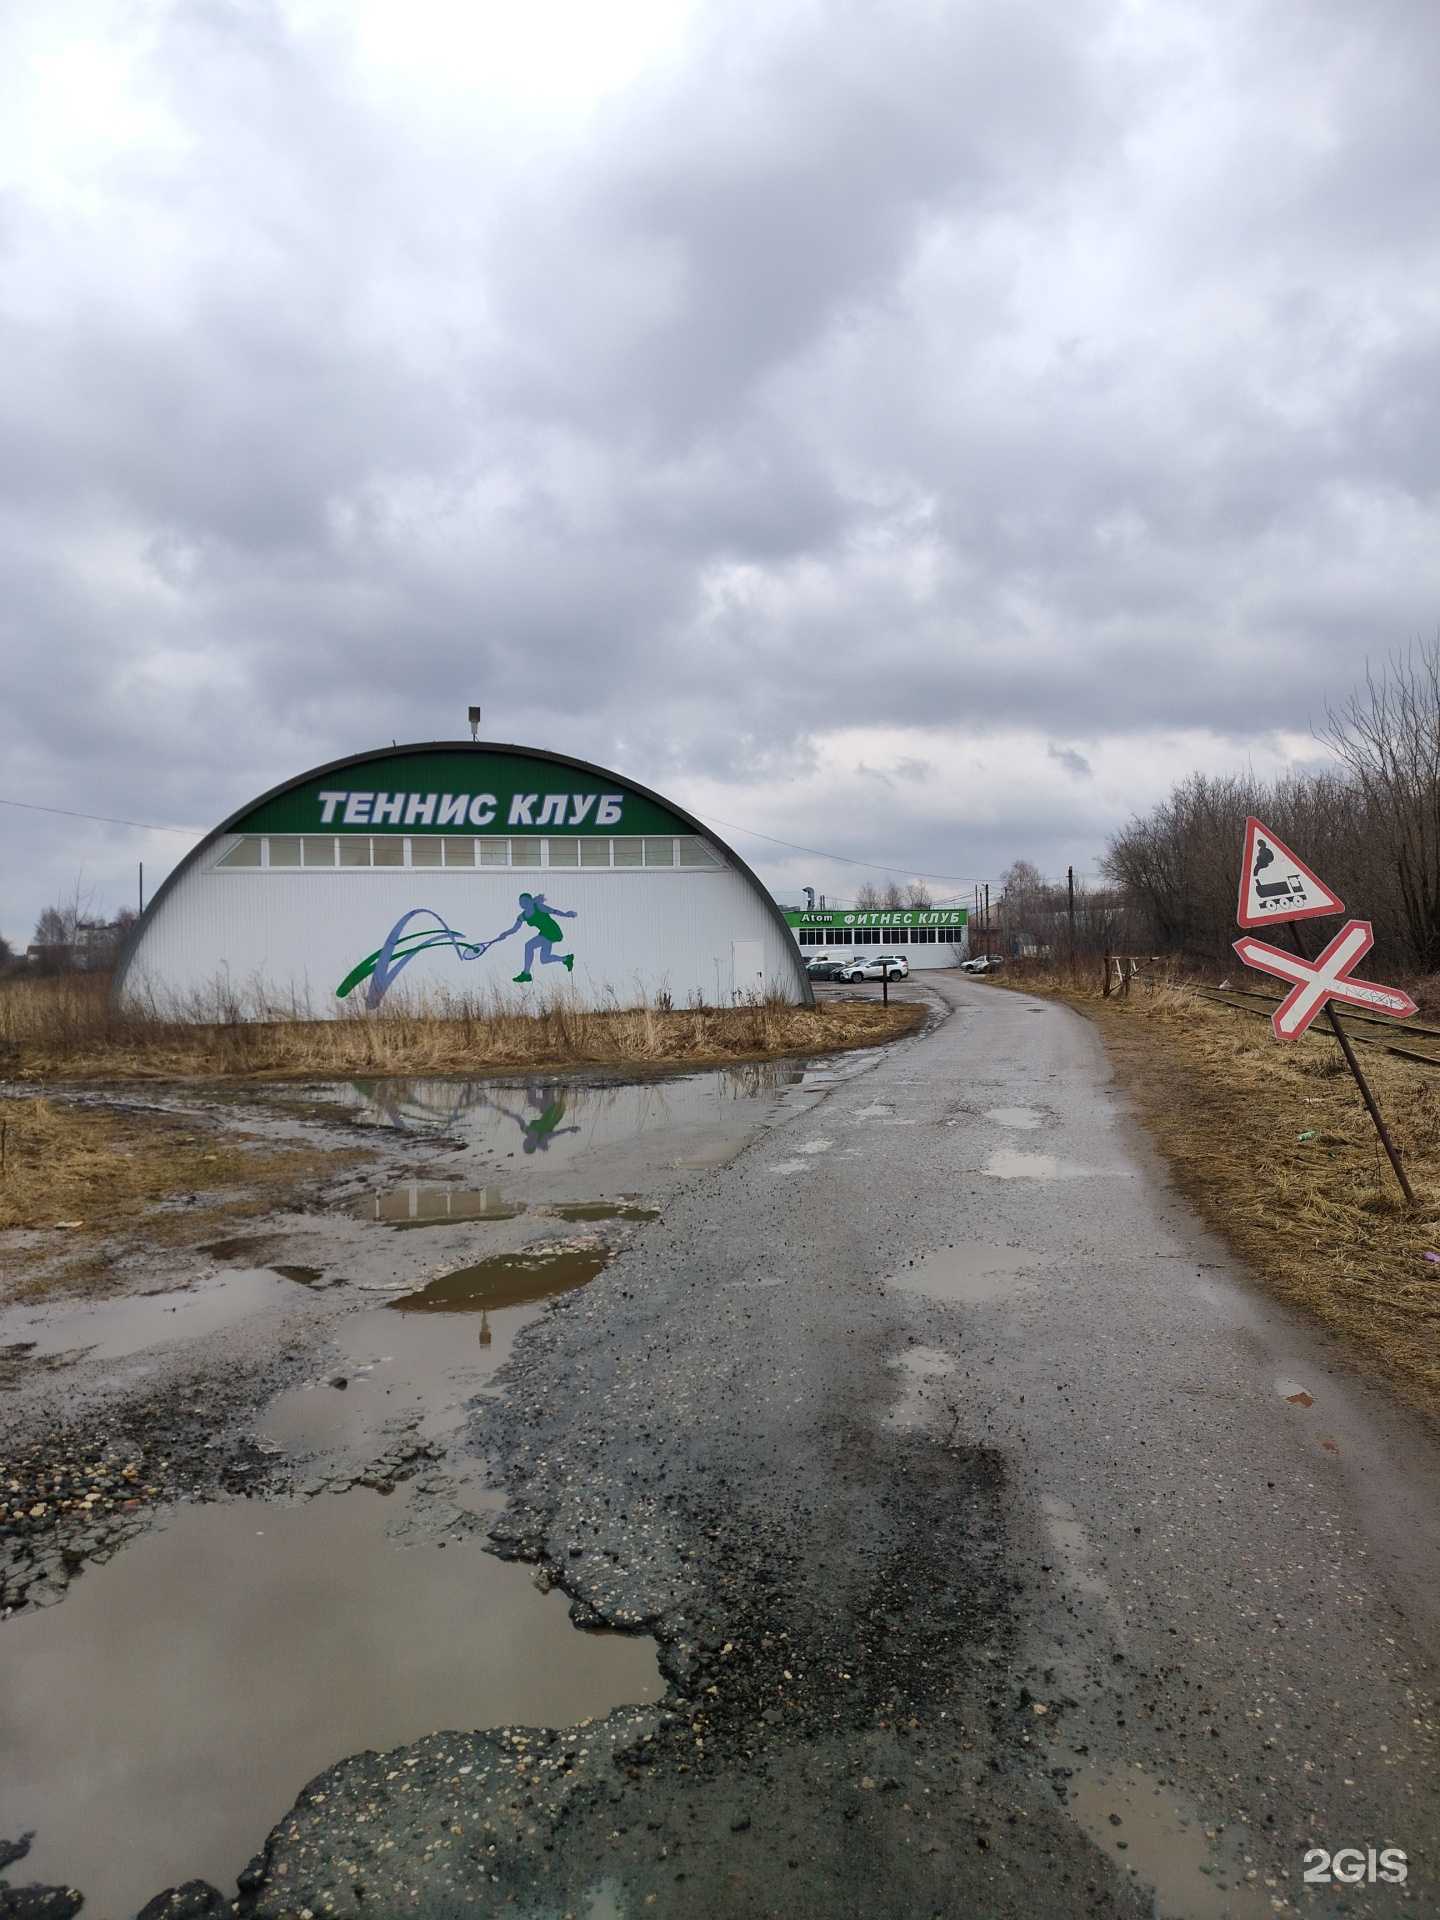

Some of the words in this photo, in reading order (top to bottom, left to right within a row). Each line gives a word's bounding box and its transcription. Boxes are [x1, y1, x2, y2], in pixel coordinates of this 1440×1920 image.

[318, 791, 498, 825] ТЕННИС
[507, 793, 624, 826] КЛУБ
[801, 913, 833, 922] Atom
[843, 913, 913, 925] ФИТНЕС
[918, 912, 960, 924] КЛУБ
